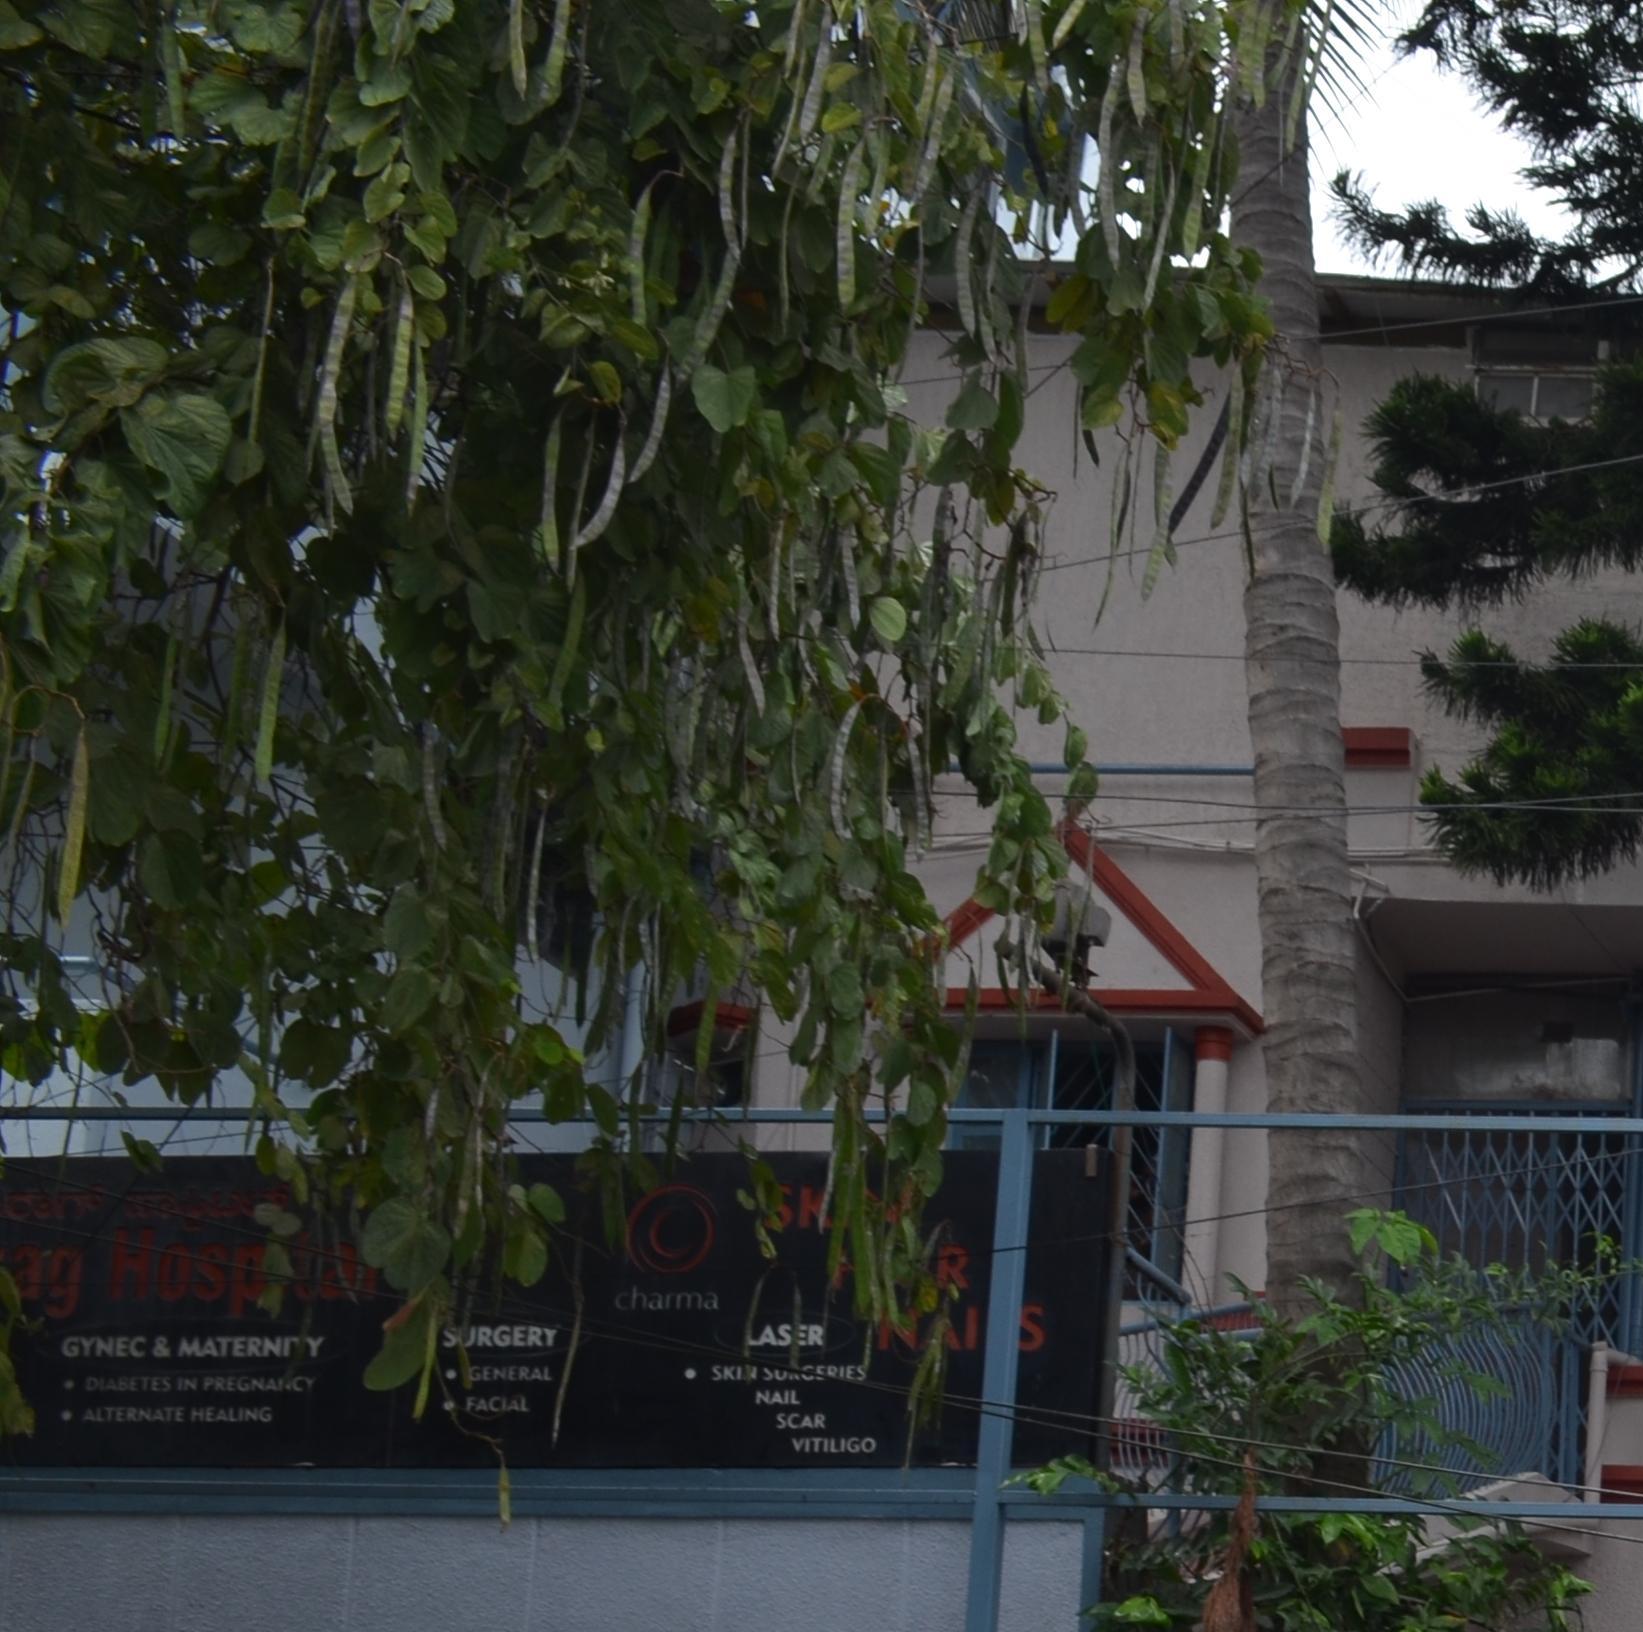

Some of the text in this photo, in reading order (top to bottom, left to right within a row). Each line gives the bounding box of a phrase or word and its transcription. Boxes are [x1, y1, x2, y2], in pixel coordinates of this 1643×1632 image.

[614, 1285, 719, 1312] charma
[442, 1324, 558, 1349] SURGERY
[62, 1337, 146, 1358] GYNEC
[152, 1337, 171, 1358] &
[467, 1365, 552, 1383] GENERAL
[85, 1376, 171, 1392] DIABETES
[177, 1377, 198, 1391] IN
[465, 1395, 530, 1413] FACIAL
[755, 1389, 801, 1405] NAIL
[83, 1406, 273, 1423] ALTERNATE HEALING
[776, 1412, 826, 1430] SCAR
[791, 1436, 877, 1455] VITILIGO
